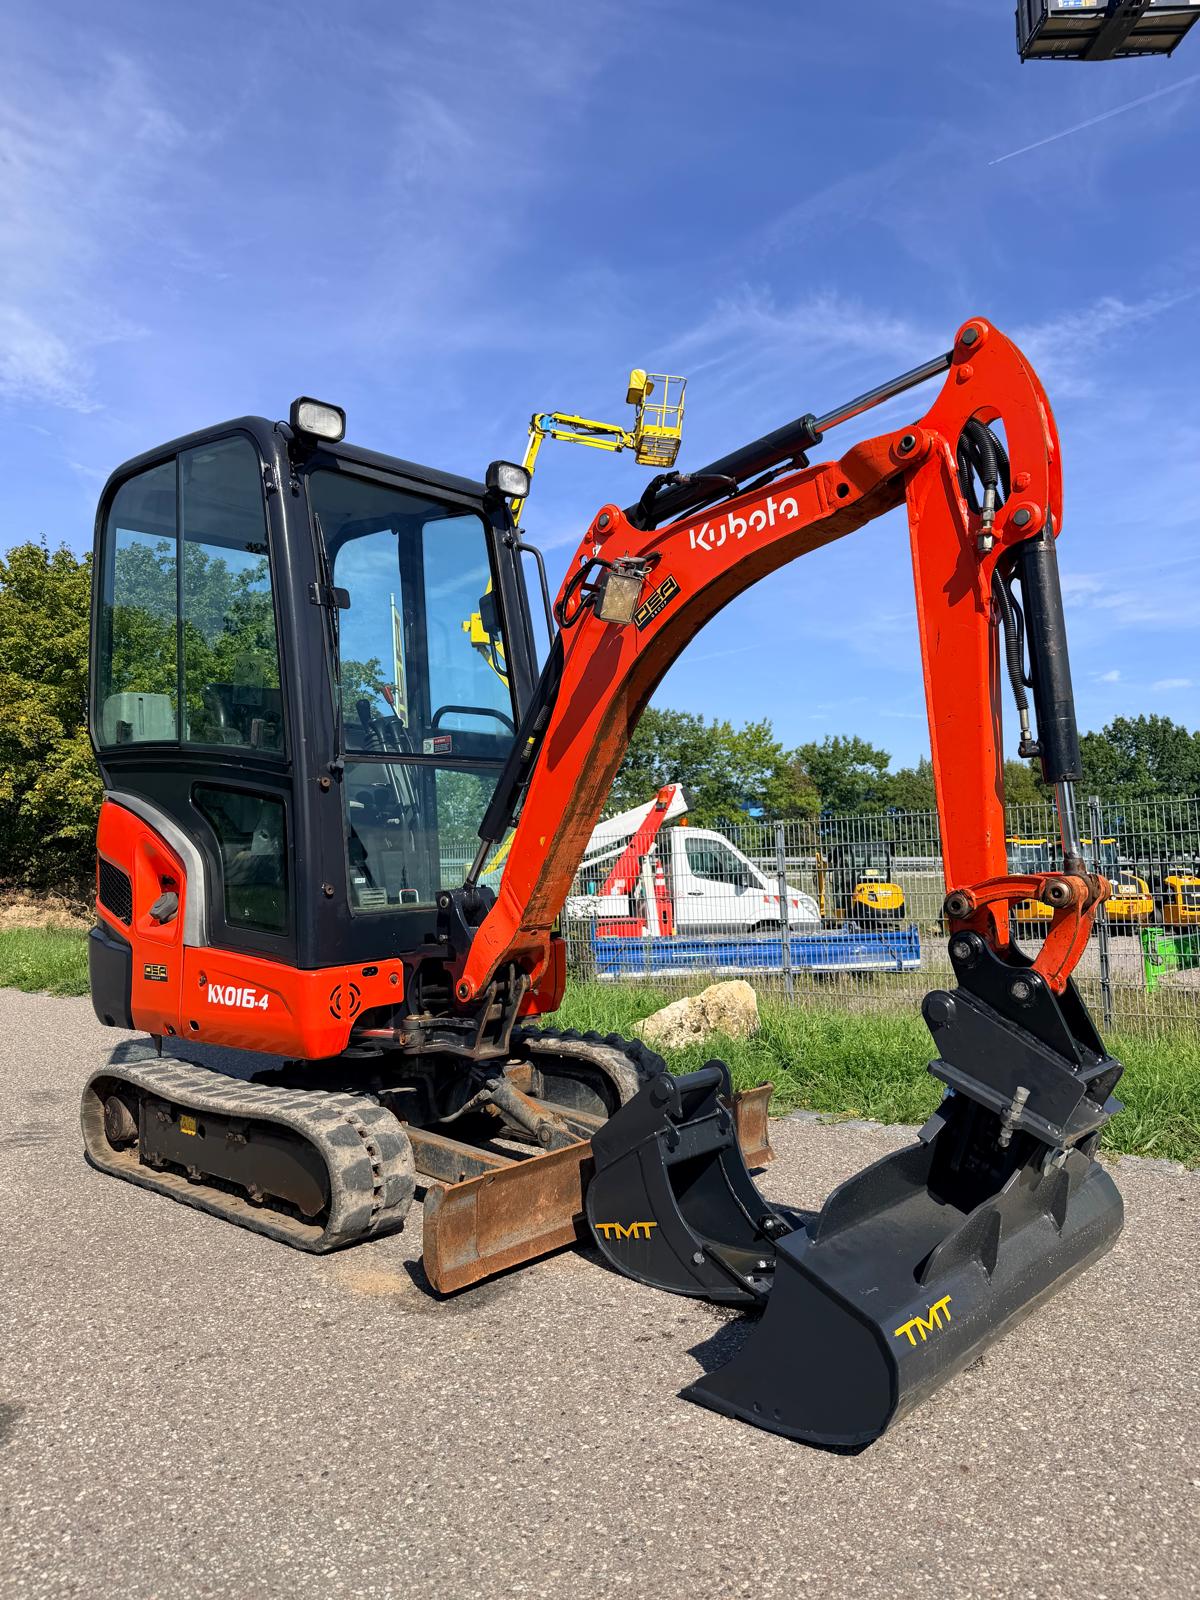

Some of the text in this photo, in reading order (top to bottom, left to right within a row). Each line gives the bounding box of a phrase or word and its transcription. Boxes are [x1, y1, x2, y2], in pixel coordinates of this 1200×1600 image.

[689, 496, 799, 551] Kubota
[594, 1221, 658, 1240] TMT
[894, 1294, 952, 1346] TMT
